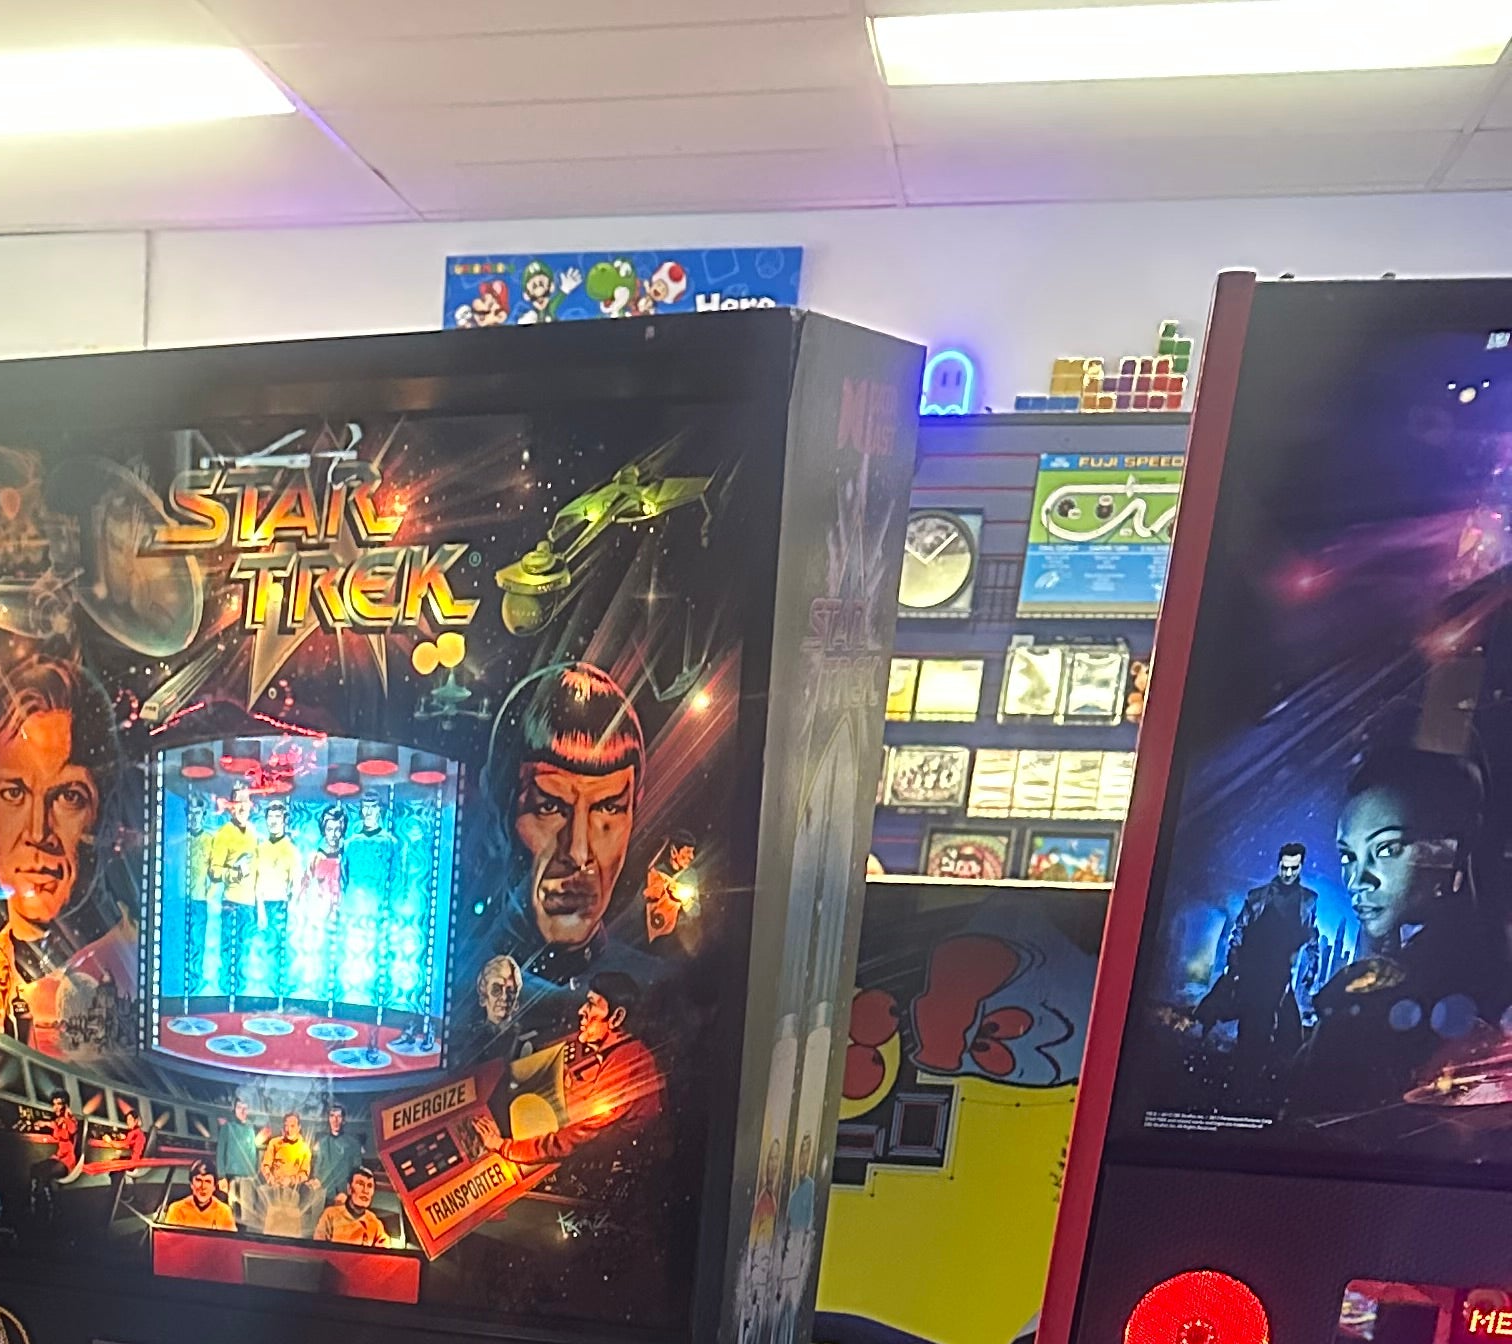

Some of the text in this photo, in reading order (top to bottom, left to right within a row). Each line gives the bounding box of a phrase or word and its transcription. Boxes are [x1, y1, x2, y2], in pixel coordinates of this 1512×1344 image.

[1078, 456, 1118, 468] FUJI
[143, 460, 404, 547] STAR
[231, 543, 481, 629] TREK
[392, 1083, 467, 1131] ENERGIZE
[424, 1162, 508, 1226] TRANSPORTER
